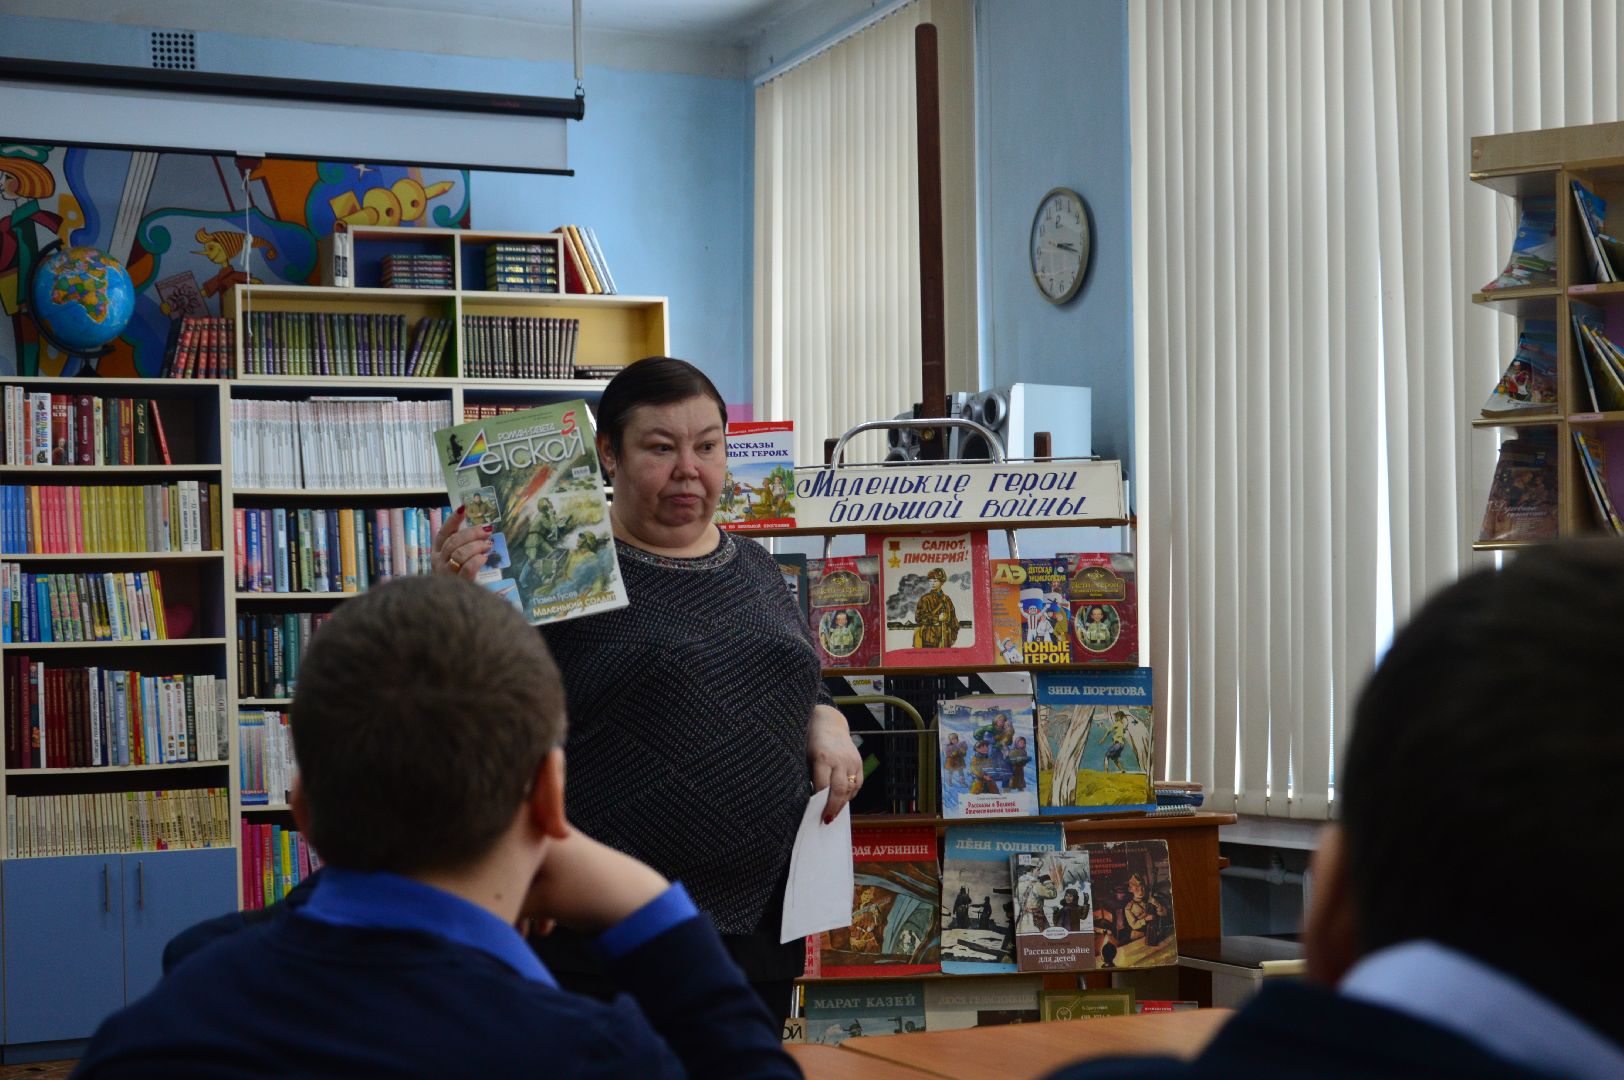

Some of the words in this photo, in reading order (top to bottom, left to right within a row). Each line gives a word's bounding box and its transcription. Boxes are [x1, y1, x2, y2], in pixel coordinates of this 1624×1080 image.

[40, 411, 48, 448] БОЛЬШАЯ
[561, 411, 576, 436] 5
[497, 422, 556, 441] РОМАН-ГАЗЕТА
[796, 469, 971, 499] Маленькие
[988, 471, 1077, 495] герои
[829, 493, 964, 523] большой
[979, 493, 1089, 518] войны
[903, 550, 968, 564] ПИОНЕРИЯ!
[1028, 566, 1052, 574] ДЕТСКАЯ
[1024, 640, 1070, 653] ЮНЫЕ
[1025, 652, 1070, 664] ГЕРОИ
[1048, 686, 1080, 696] ЗИНА
[1083, 686, 1147, 696] ПОРТНОВА
[852, 846, 871, 855] ОДЯ
[872, 845, 929, 855] ДУБИНИН
[955, 837, 992, 851] ЛЁНЯ
[995, 840, 1056, 852] ГОЛИКОВ
[1023, 947, 1059, 956] Рассказы
[1066, 946, 1090, 954] войне
[1053, 954, 1077, 963] детей
[814, 998, 861, 1009] МАРАТ
[865, 993, 917, 1008] КАЗЕЙ
[782, 1023, 803, 1040] ОЙ
